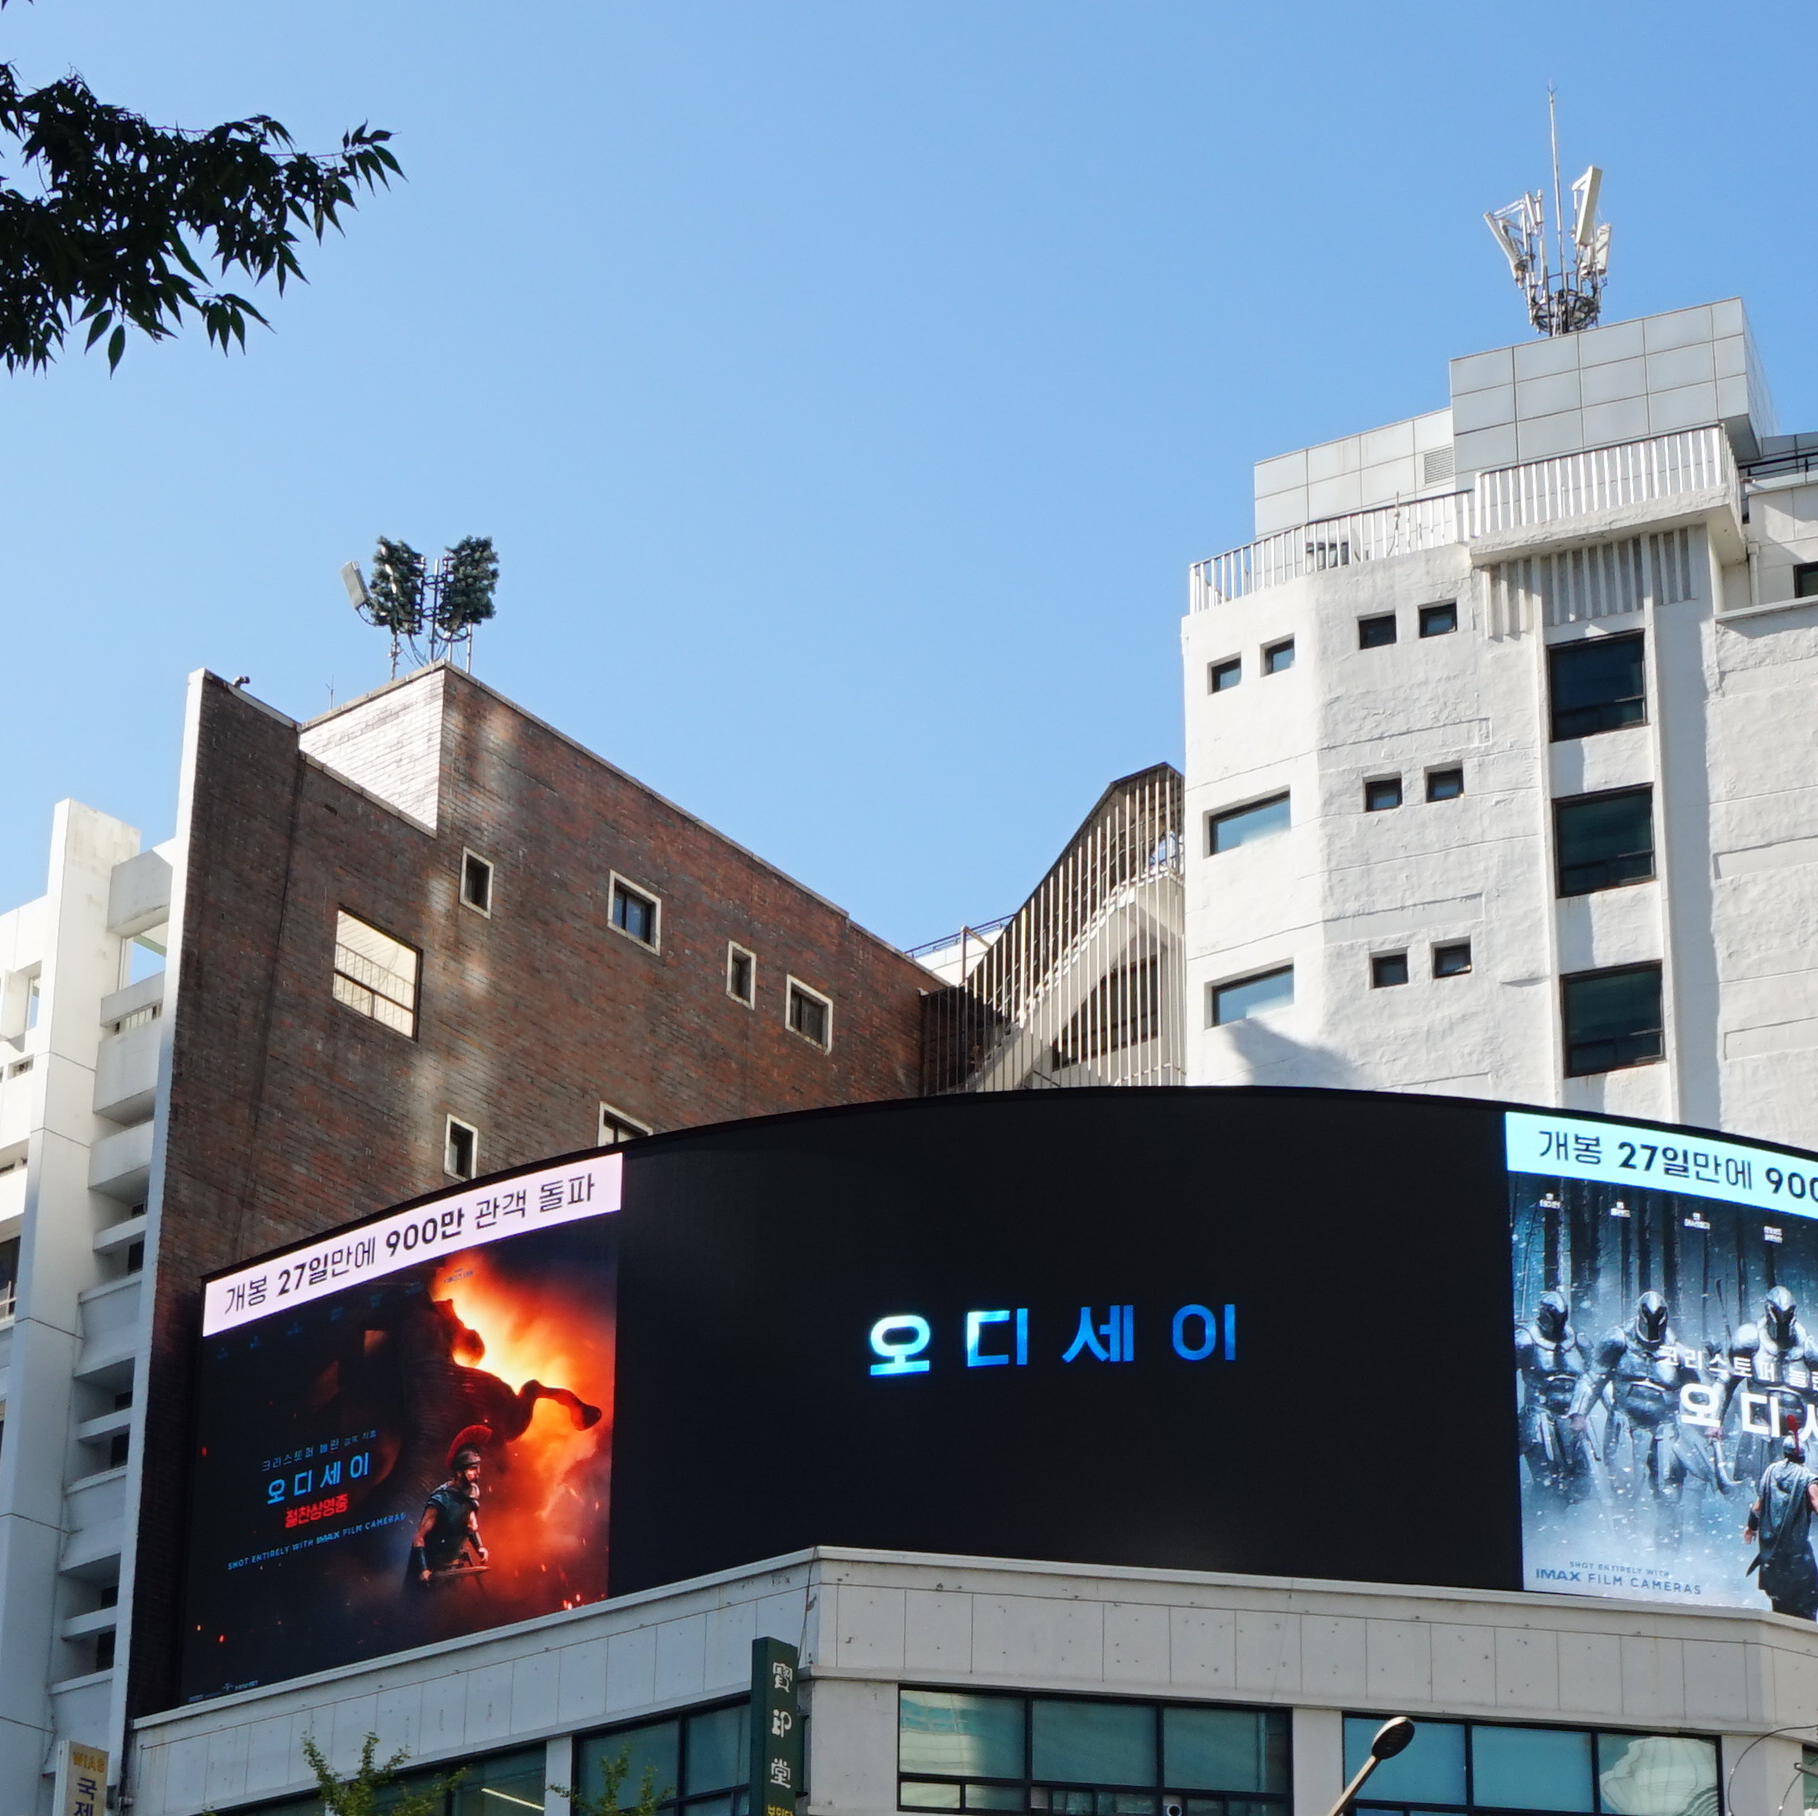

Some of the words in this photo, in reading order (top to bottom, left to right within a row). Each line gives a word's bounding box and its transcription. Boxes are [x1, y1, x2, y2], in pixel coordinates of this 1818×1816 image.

[1539, 1130, 1602, 1165] 개봉
[1618, 1141, 1752, 1190] 27일만에
[224, 1275, 268, 1315] 개봉
[277, 1236, 376, 1297] 27일만에
[386, 1210, 465, 1258] 900만
[475, 1190, 526, 1229] 관객
[539, 1173, 595, 1213] 돌파
[284, 1493, 349, 1528] 절찬상영중
[252, 1546, 290, 1563] ENTIRELY
[292, 1540, 314, 1551] WITH
[343, 1525, 363, 1537] FILM
[1536, 1568, 1581, 1582] IMAX
[1588, 1573, 1623, 1587] FILM
[1631, 1577, 1702, 1595] CAMERAS
